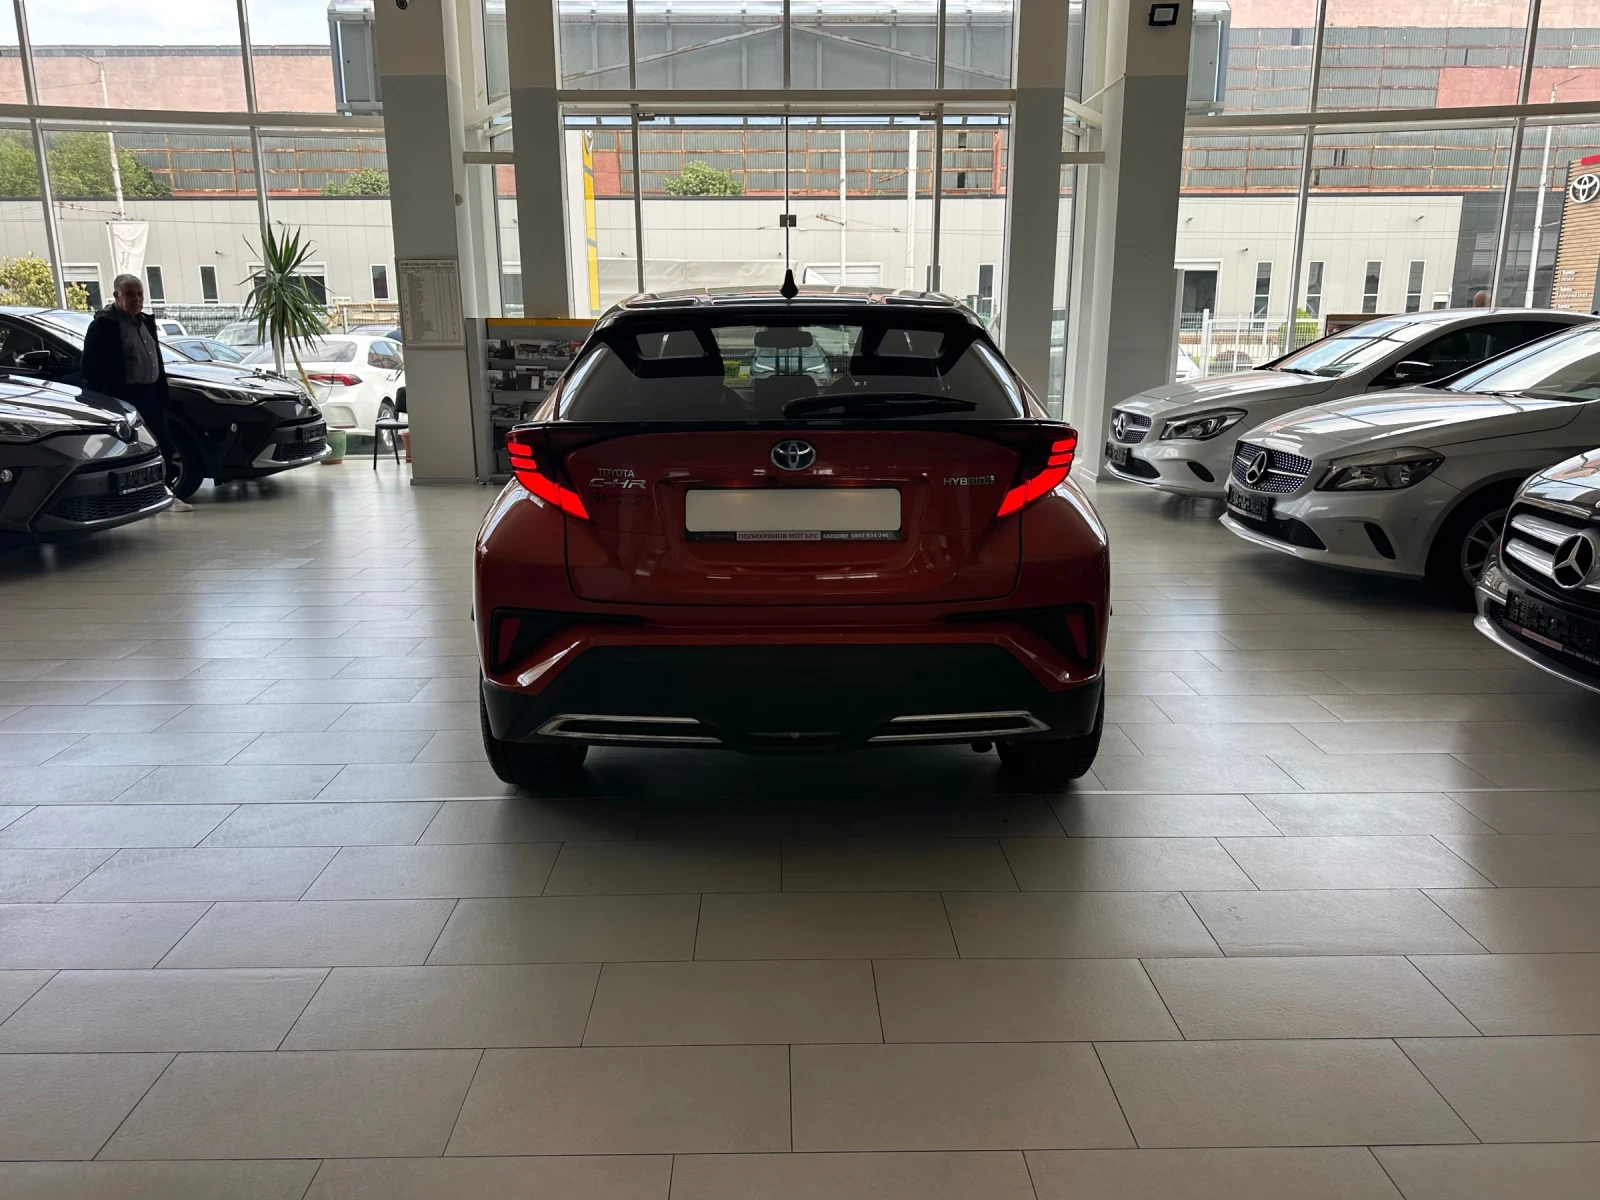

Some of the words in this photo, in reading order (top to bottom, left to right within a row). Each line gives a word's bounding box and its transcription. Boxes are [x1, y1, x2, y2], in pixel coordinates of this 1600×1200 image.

[597, 468, 635, 478] TOYOTA
[588, 477, 647, 490] C-HR
[738, 532, 787, 540] ПОЛИХРОНОВ
[788, 532, 819, 540] МОТЪРС
